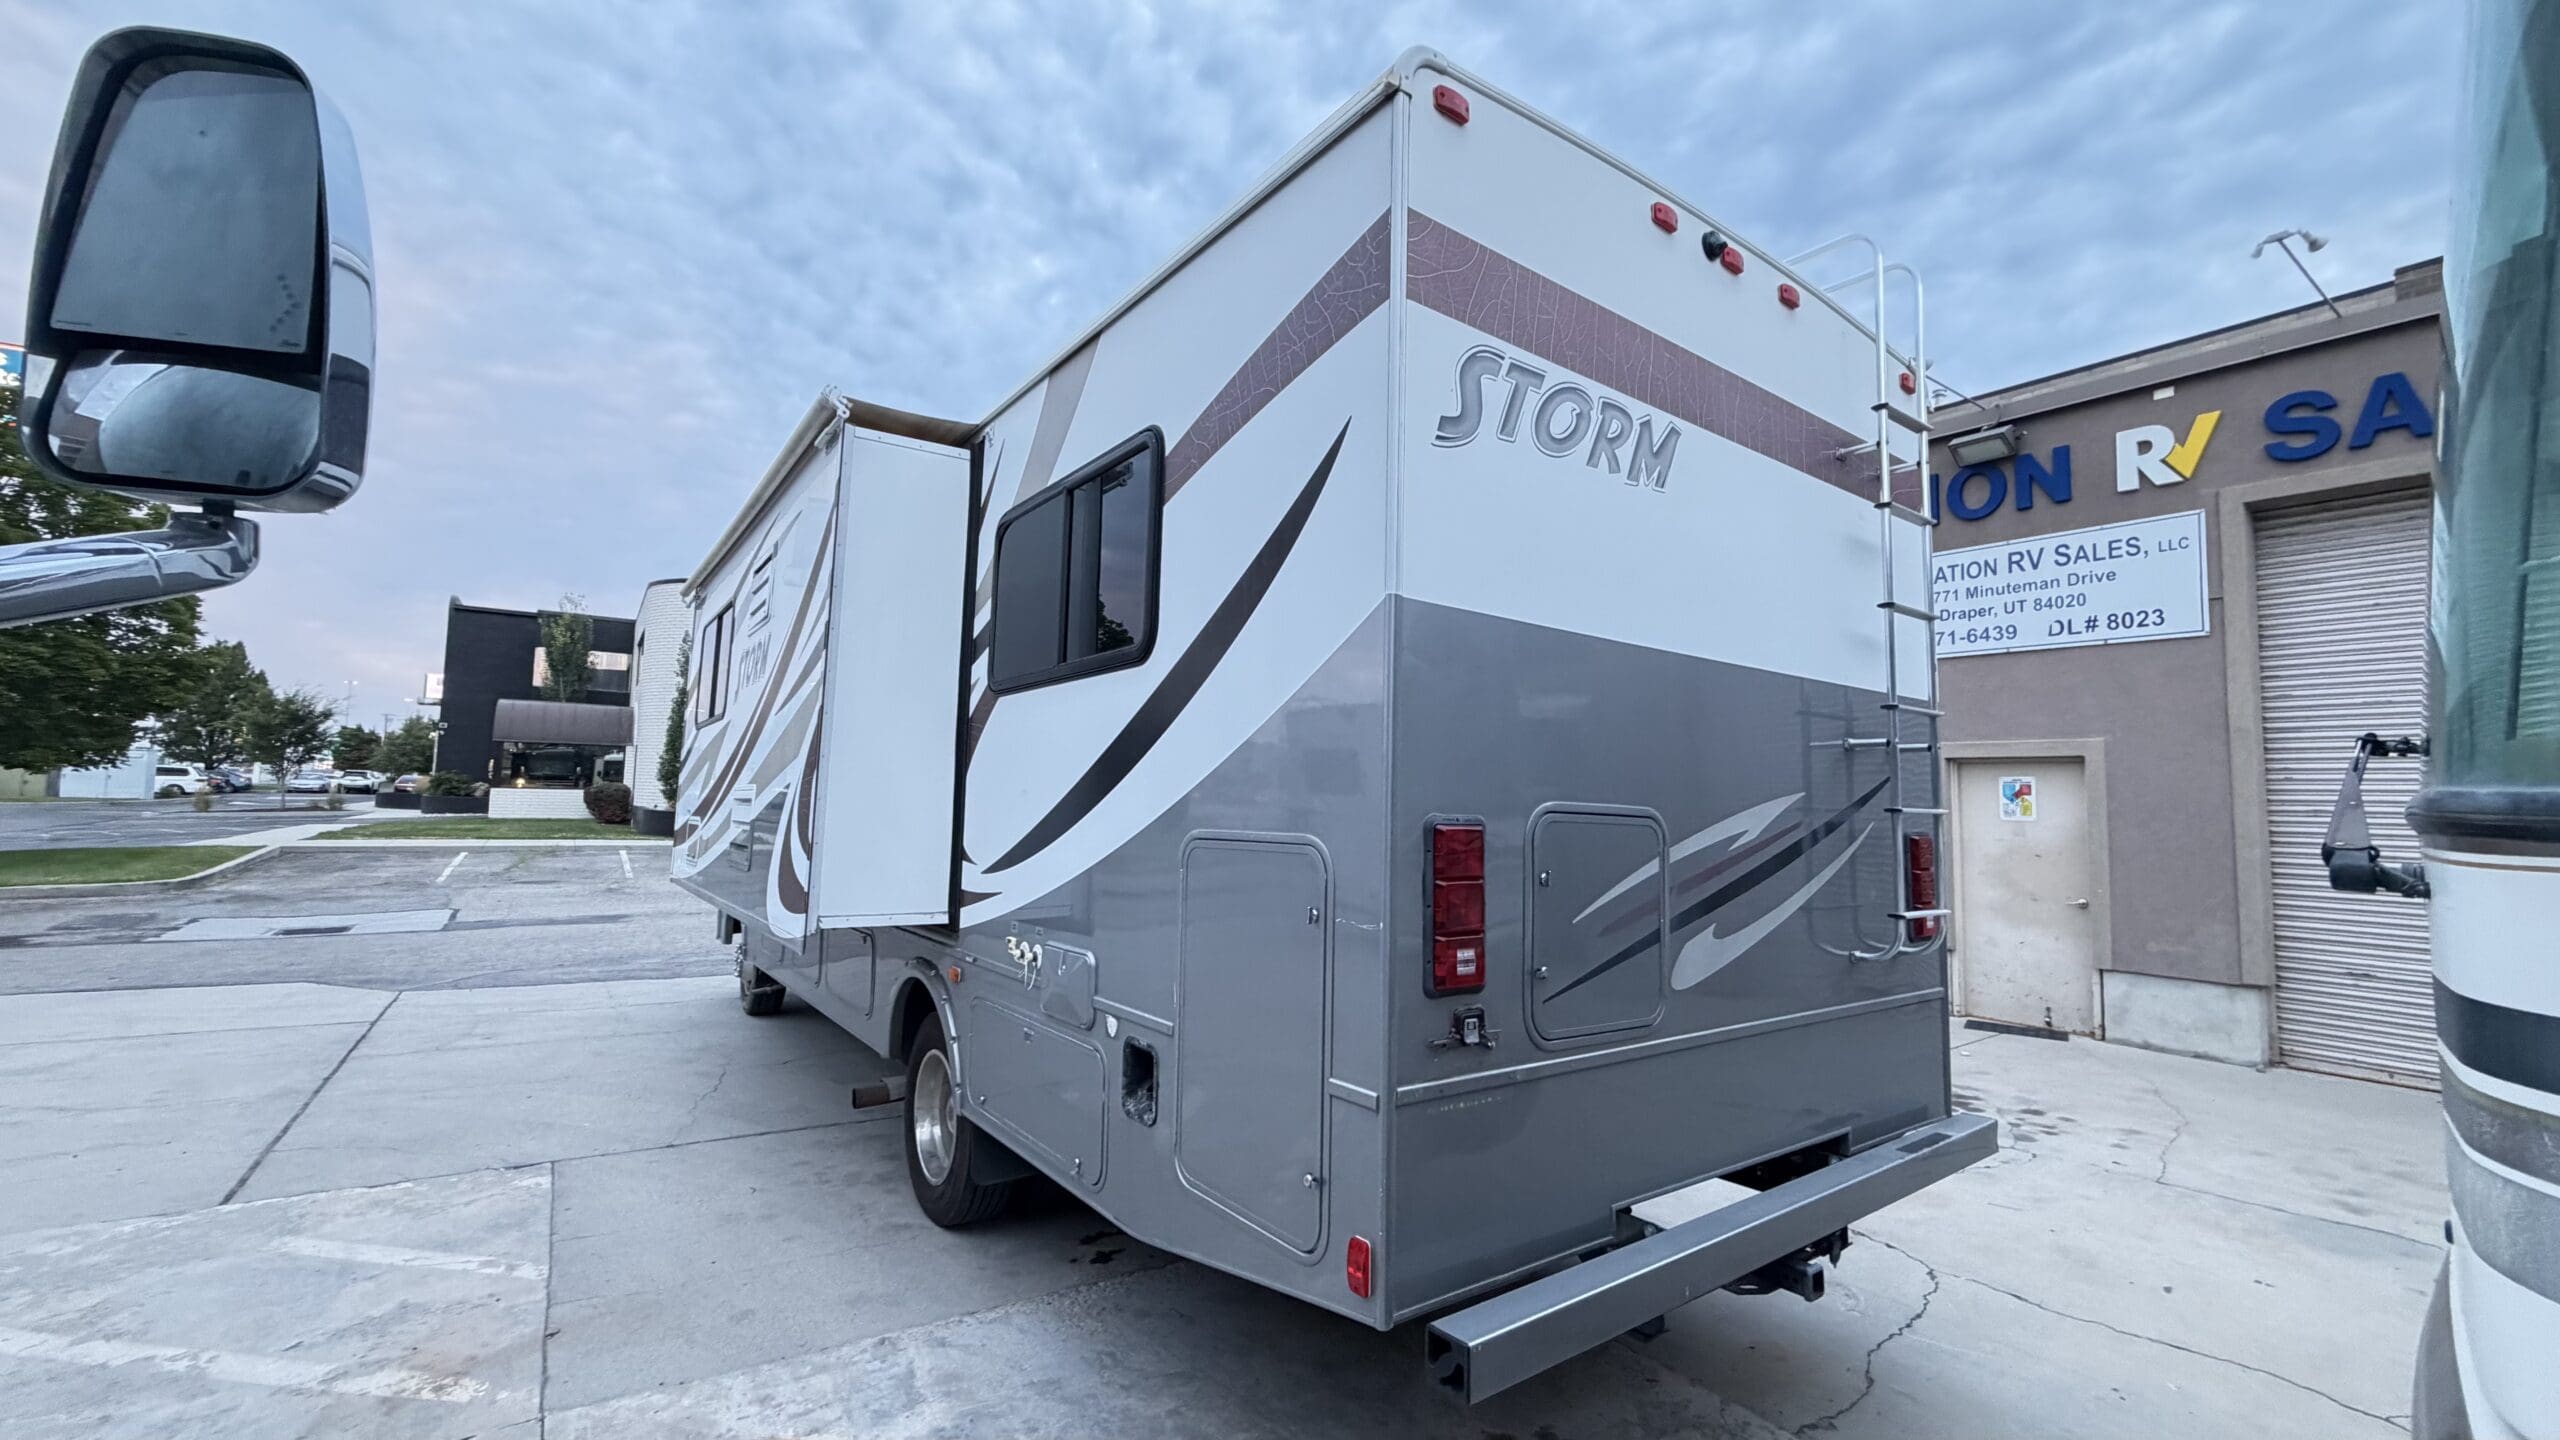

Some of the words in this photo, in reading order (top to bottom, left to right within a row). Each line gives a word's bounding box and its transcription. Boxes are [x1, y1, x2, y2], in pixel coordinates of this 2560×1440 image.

[1431, 344, 1682, 493] STORM
[1934, 557, 1998, 585] ATION
[2007, 547, 2045, 575] RV
[2053, 536, 2150, 567] SALES,
[2158, 536, 2190, 553] LLC
[1965, 578, 2061, 600] Minuteman
[2067, 569, 2117, 587] Drive
[1940, 605, 1998, 622] Draper,
[2003, 599, 2028, 615] UT
[2032, 592, 2087, 612] 84020
[1935, 624, 2018, 646] 71-6439
[2106, 608, 2165, 631] 8023
